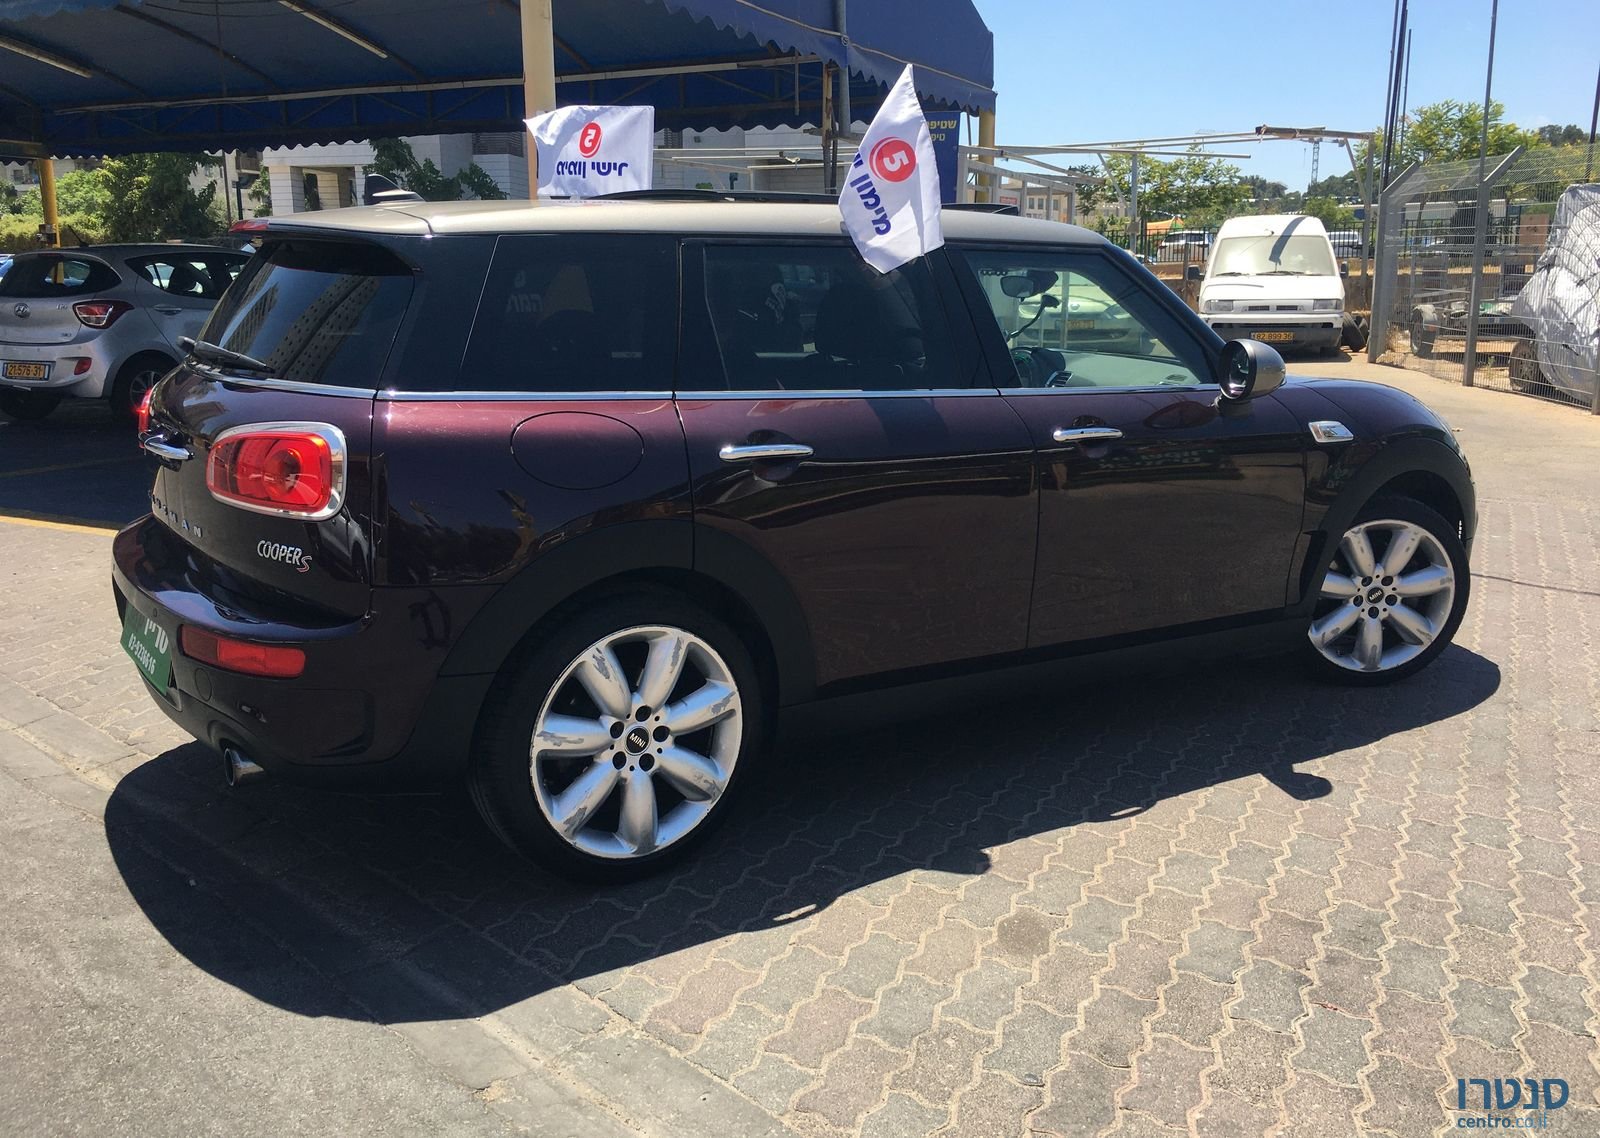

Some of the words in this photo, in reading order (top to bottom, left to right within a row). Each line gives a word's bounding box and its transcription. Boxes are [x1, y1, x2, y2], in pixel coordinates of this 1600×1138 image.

[883, 150, 910, 172] 5
[850, 173, 892, 236] מימון
[629, 732, 647, 748] MINI
